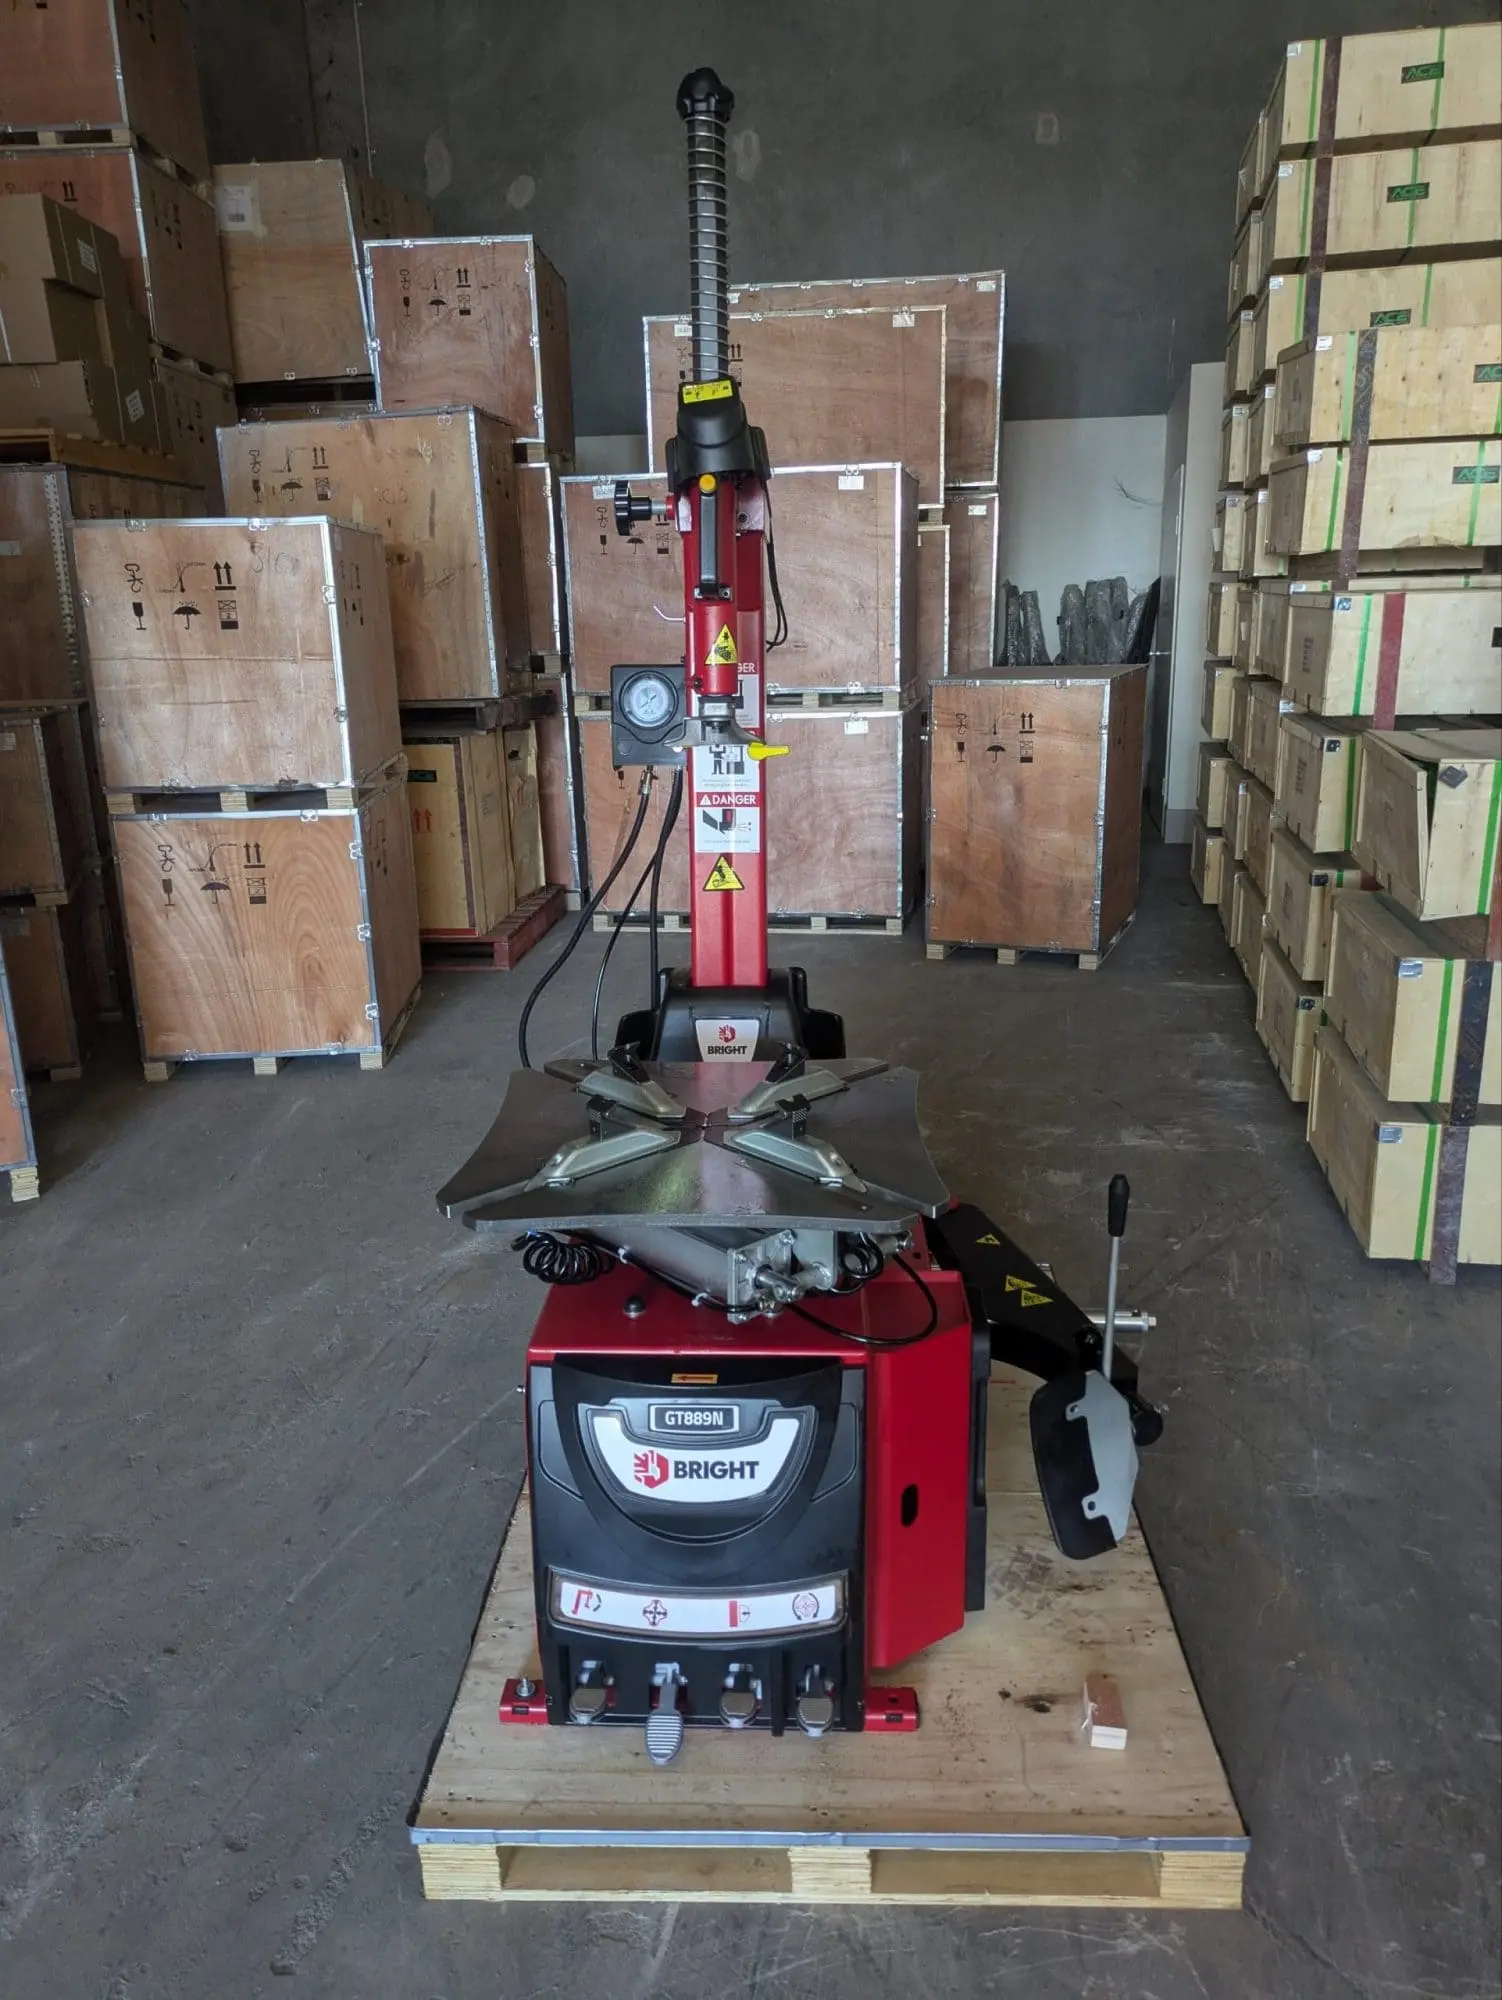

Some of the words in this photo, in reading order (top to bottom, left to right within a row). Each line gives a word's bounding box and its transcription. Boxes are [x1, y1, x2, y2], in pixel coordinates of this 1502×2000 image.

[712, 794, 756, 805] DANGER
[707, 1045, 748, 1055] BRIGHT
[664, 1411, 724, 1426] GT889N
[673, 1460, 760, 1480] BRIGHT
